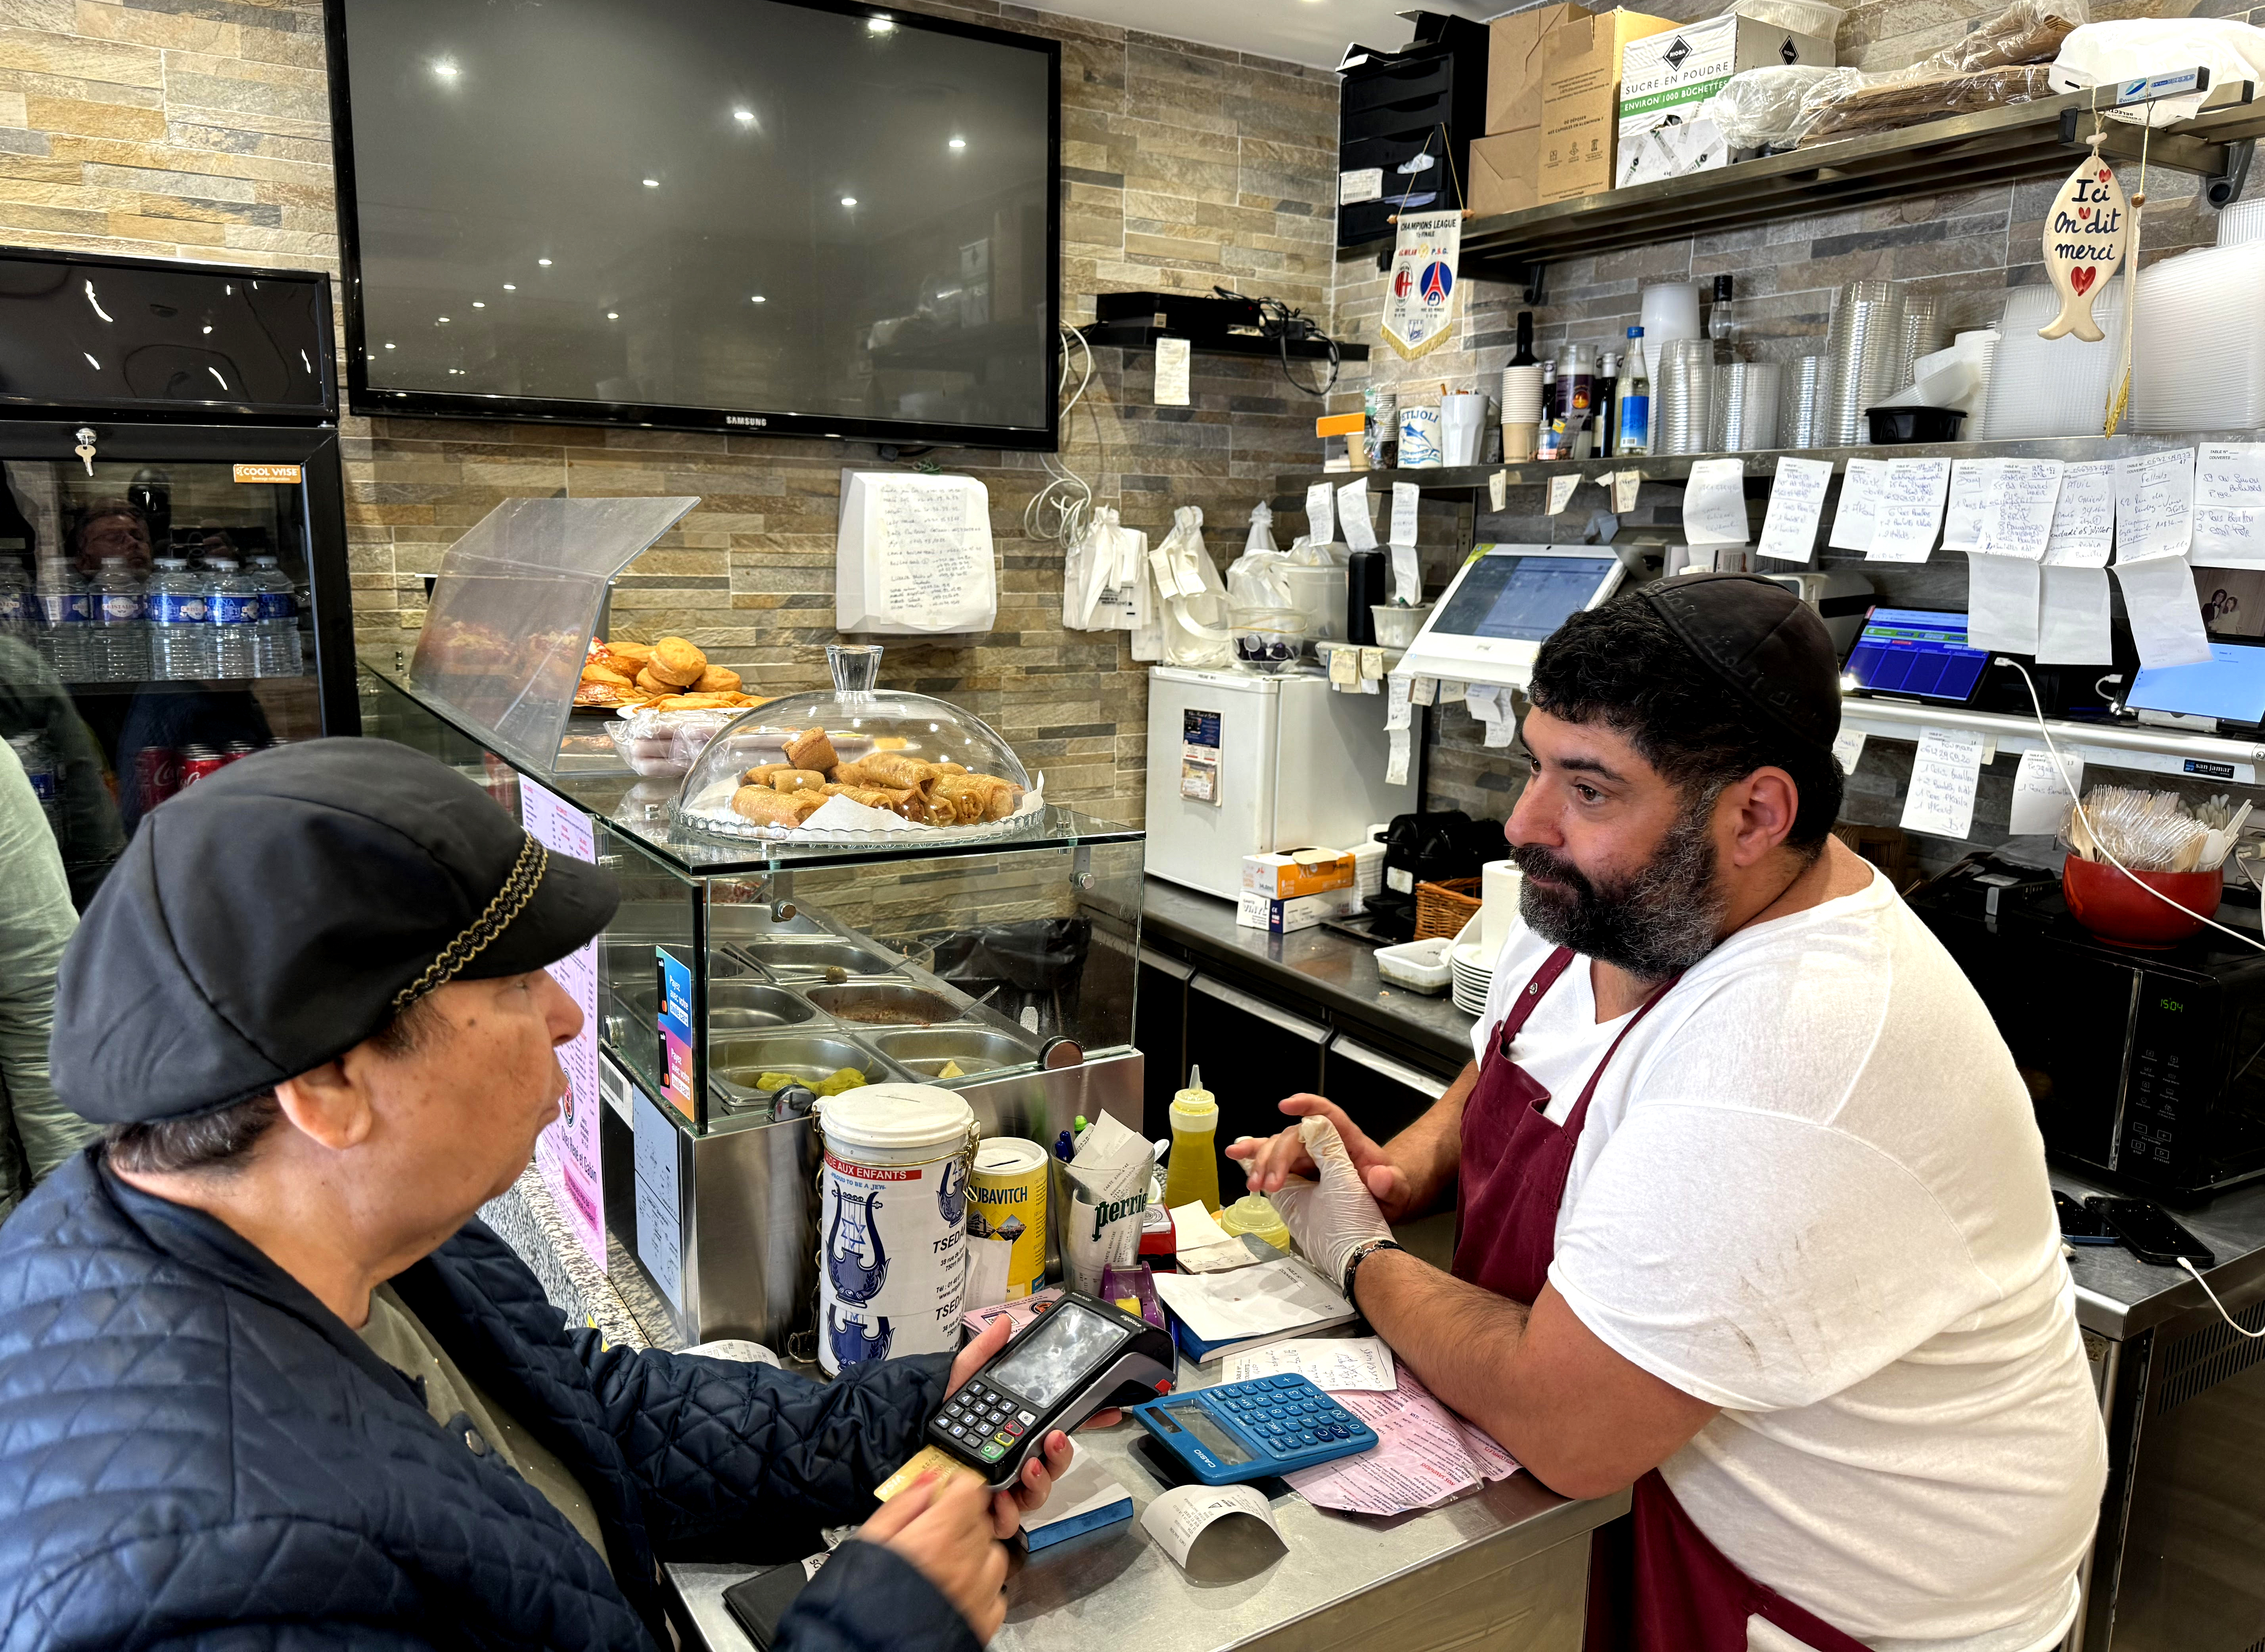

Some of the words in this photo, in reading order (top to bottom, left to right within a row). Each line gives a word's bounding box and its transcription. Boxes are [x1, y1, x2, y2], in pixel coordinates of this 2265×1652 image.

[1669, 49, 1686, 57] RIOBA
[1626, 79, 1659, 94] SUCRE
[1665, 75, 1677, 85] EN
[1684, 61, 1728, 80] POUDRE
[1625, 97, 1659, 111] ENVIRON
[1662, 92, 1678, 102] 1000
[2071, 178, 2110, 203] Ici
[1401, 221, 1432, 231] CHAMPIONS
[1434, 219, 1456, 228] LEAGUE
[2054, 211, 2082, 234] On
[2085, 207, 2121, 234] dit
[2055, 243, 2116, 261] merci
[726, 416, 767, 426] SAMSUNG
[1401, 410, 1439, 423] ETIJOLI
[2209, 764, 2231, 773] jamar
[669, 975, 680, 992] Payez
[670, 989, 678, 1003] avec
[679, 995, 688, 1010] votre
[671, 1002, 680, 1018] smile
[680, 1011, 688, 1026] card
[671, 1048, 682, 1065] Payez
[672, 1062, 680, 1075] avec
[680, 1069, 690, 1084] votre
[681, 1085, 690, 1100] card
[584, 1156, 597, 1184] Gabin
[837, 1162, 854, 1175] AUX
[857, 1169, 906, 1180] ENFANTS
[1104, 1181, 1114, 1191] CARTE
[1092, 1188, 1149, 1242] perrie
[945, 1261, 956, 1272] 75011
[1287, 1267, 1297, 1276] TABLE
[1278, 1268, 1298, 1283] COUVERTS
[1120, 1314, 1142, 1327] ingenico
[976, 1403, 985, 1412] 5
[1331, 1409, 1347, 1419] 00
[956, 1426, 962, 1434] 0
[979, 1424, 989, 1432] 9
[1331, 1425, 1347, 1434] AC
[1193, 1449, 1217, 1468] CASIO
[878, 1474, 906, 1496] VISA
